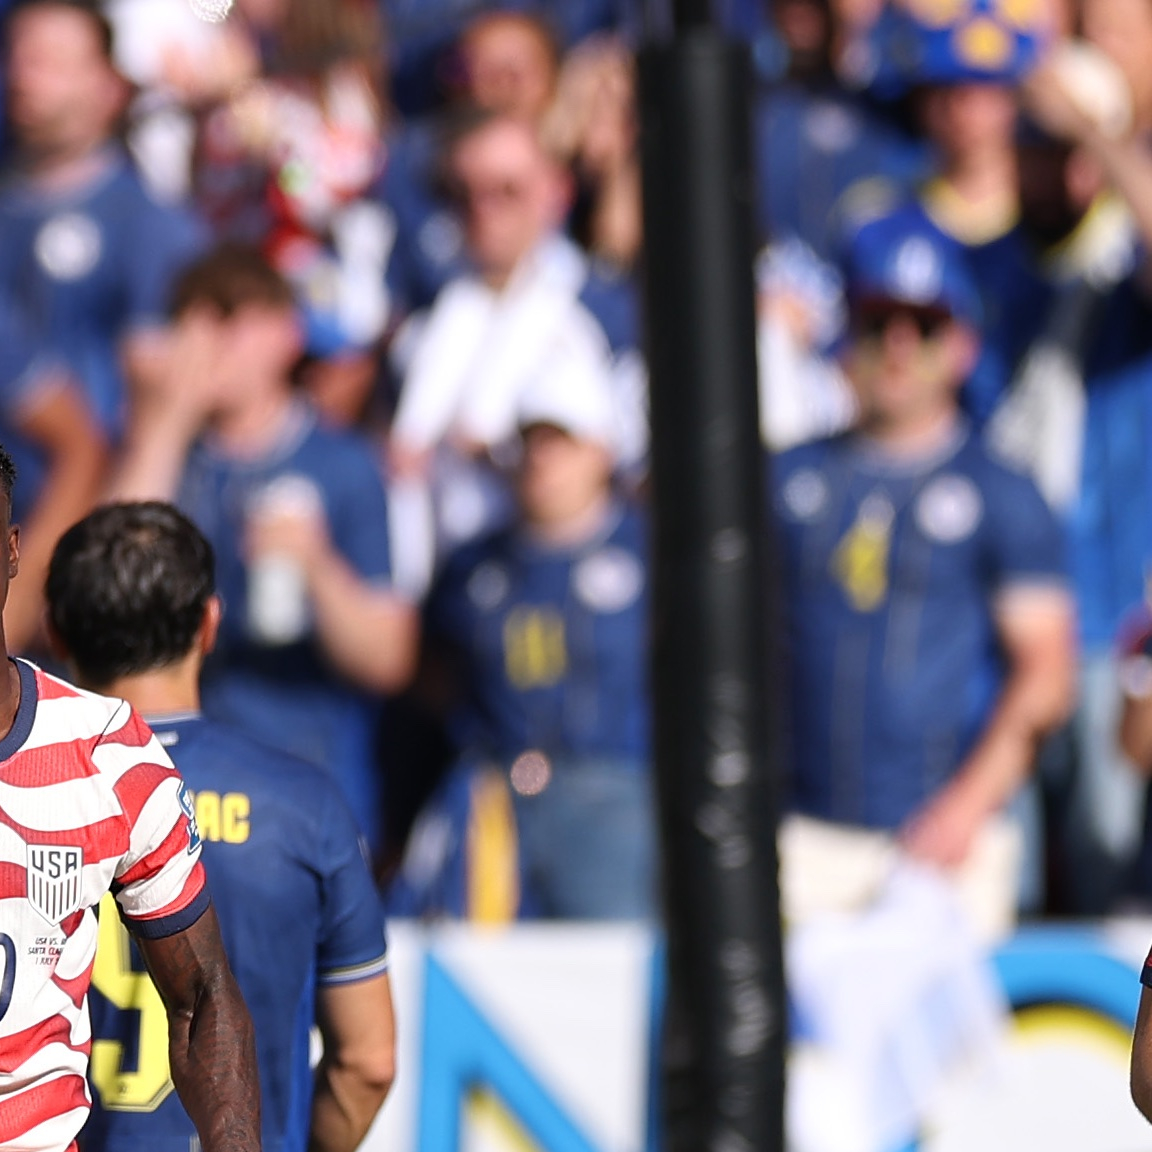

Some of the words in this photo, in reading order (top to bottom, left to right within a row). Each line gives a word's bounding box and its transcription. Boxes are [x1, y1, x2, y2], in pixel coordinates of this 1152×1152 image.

[189, 788, 251, 844] AC
[32, 849, 78, 879] USA
[35, 937, 48, 945] USA
[28, 946, 46, 955] SANTA
[40, 957, 54, 966] JULY
